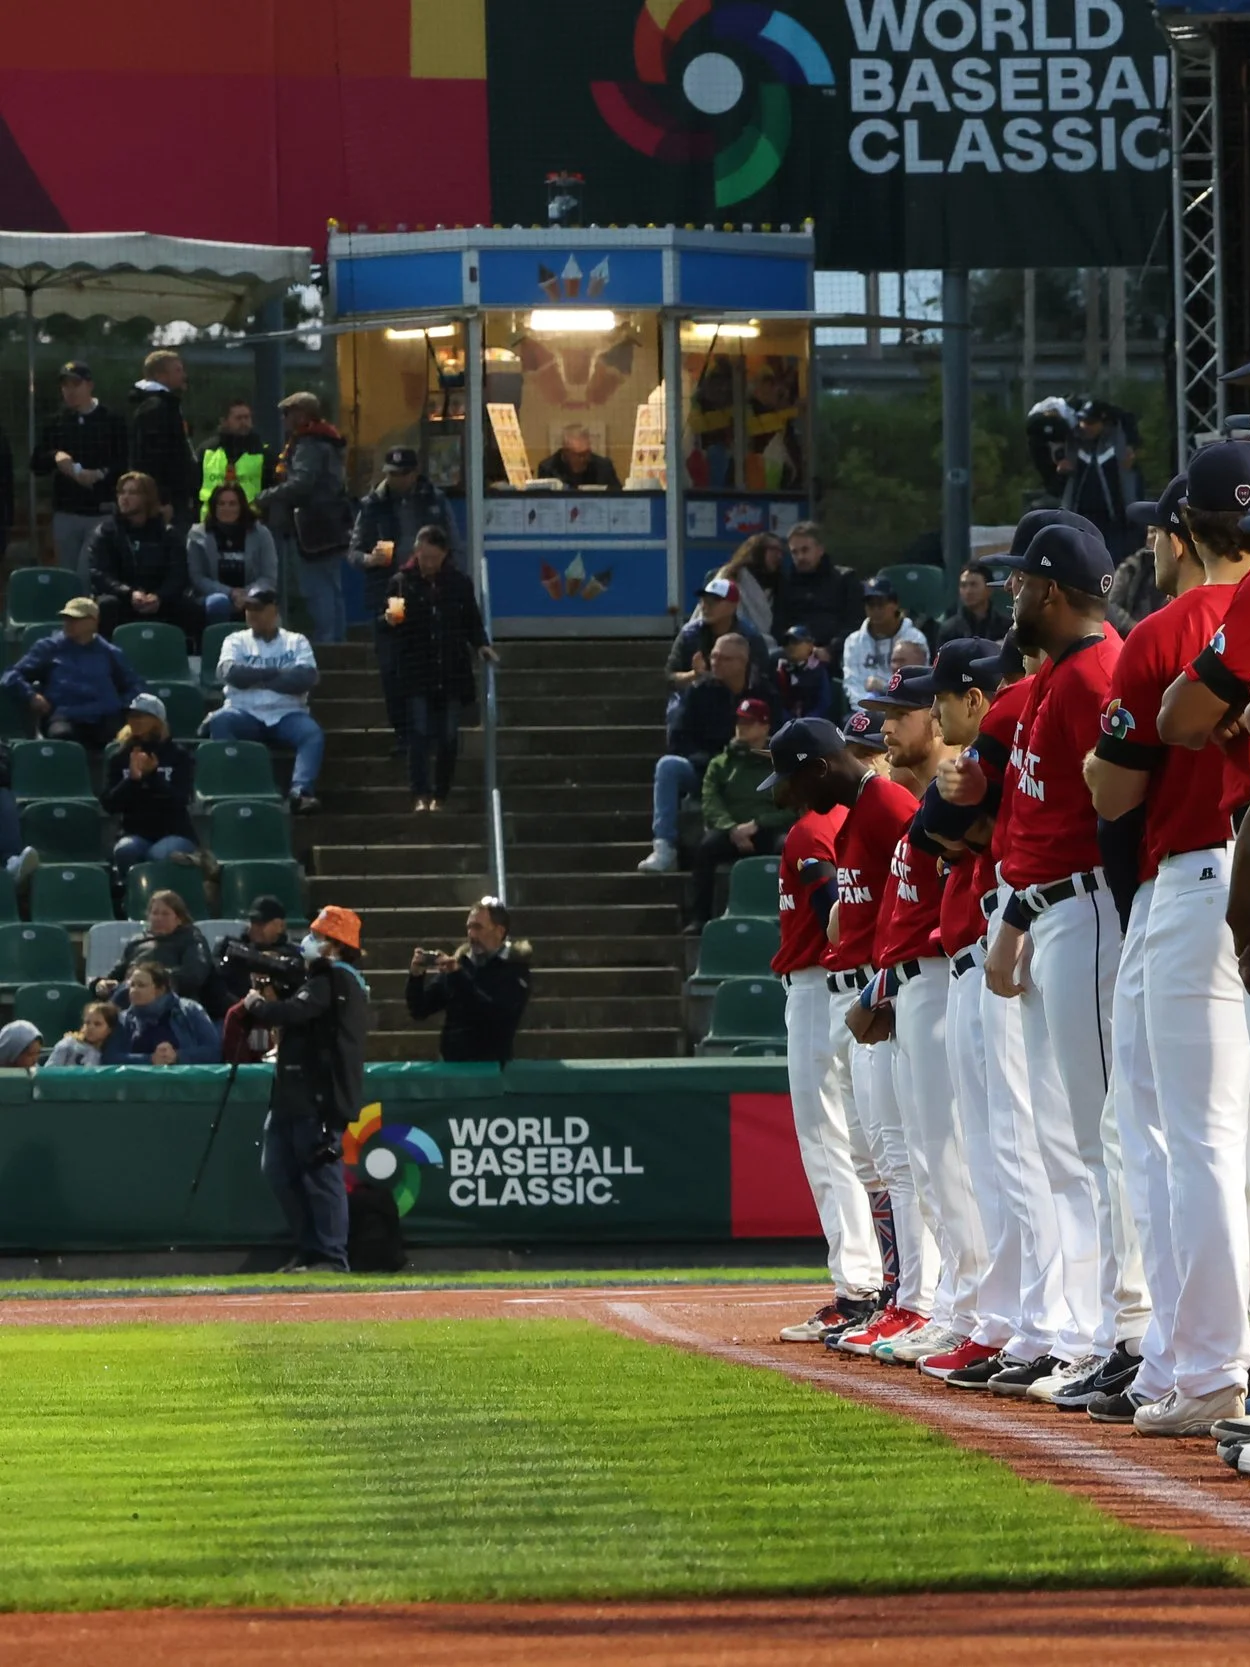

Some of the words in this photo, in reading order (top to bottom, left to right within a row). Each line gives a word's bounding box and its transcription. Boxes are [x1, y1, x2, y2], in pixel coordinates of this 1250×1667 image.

[845, 0, 1124, 52] WORLD
[849, 55, 1169, 113] BASEBA
[848, 115, 1171, 174] CLASSIC
[849, 710, 871, 732] GB
[836, 867, 861, 886] EAT
[448, 1116, 590, 1146] WORLD
[450, 1146, 644, 1176] BASEBALL
[448, 1176, 613, 1206] CLASSIC
